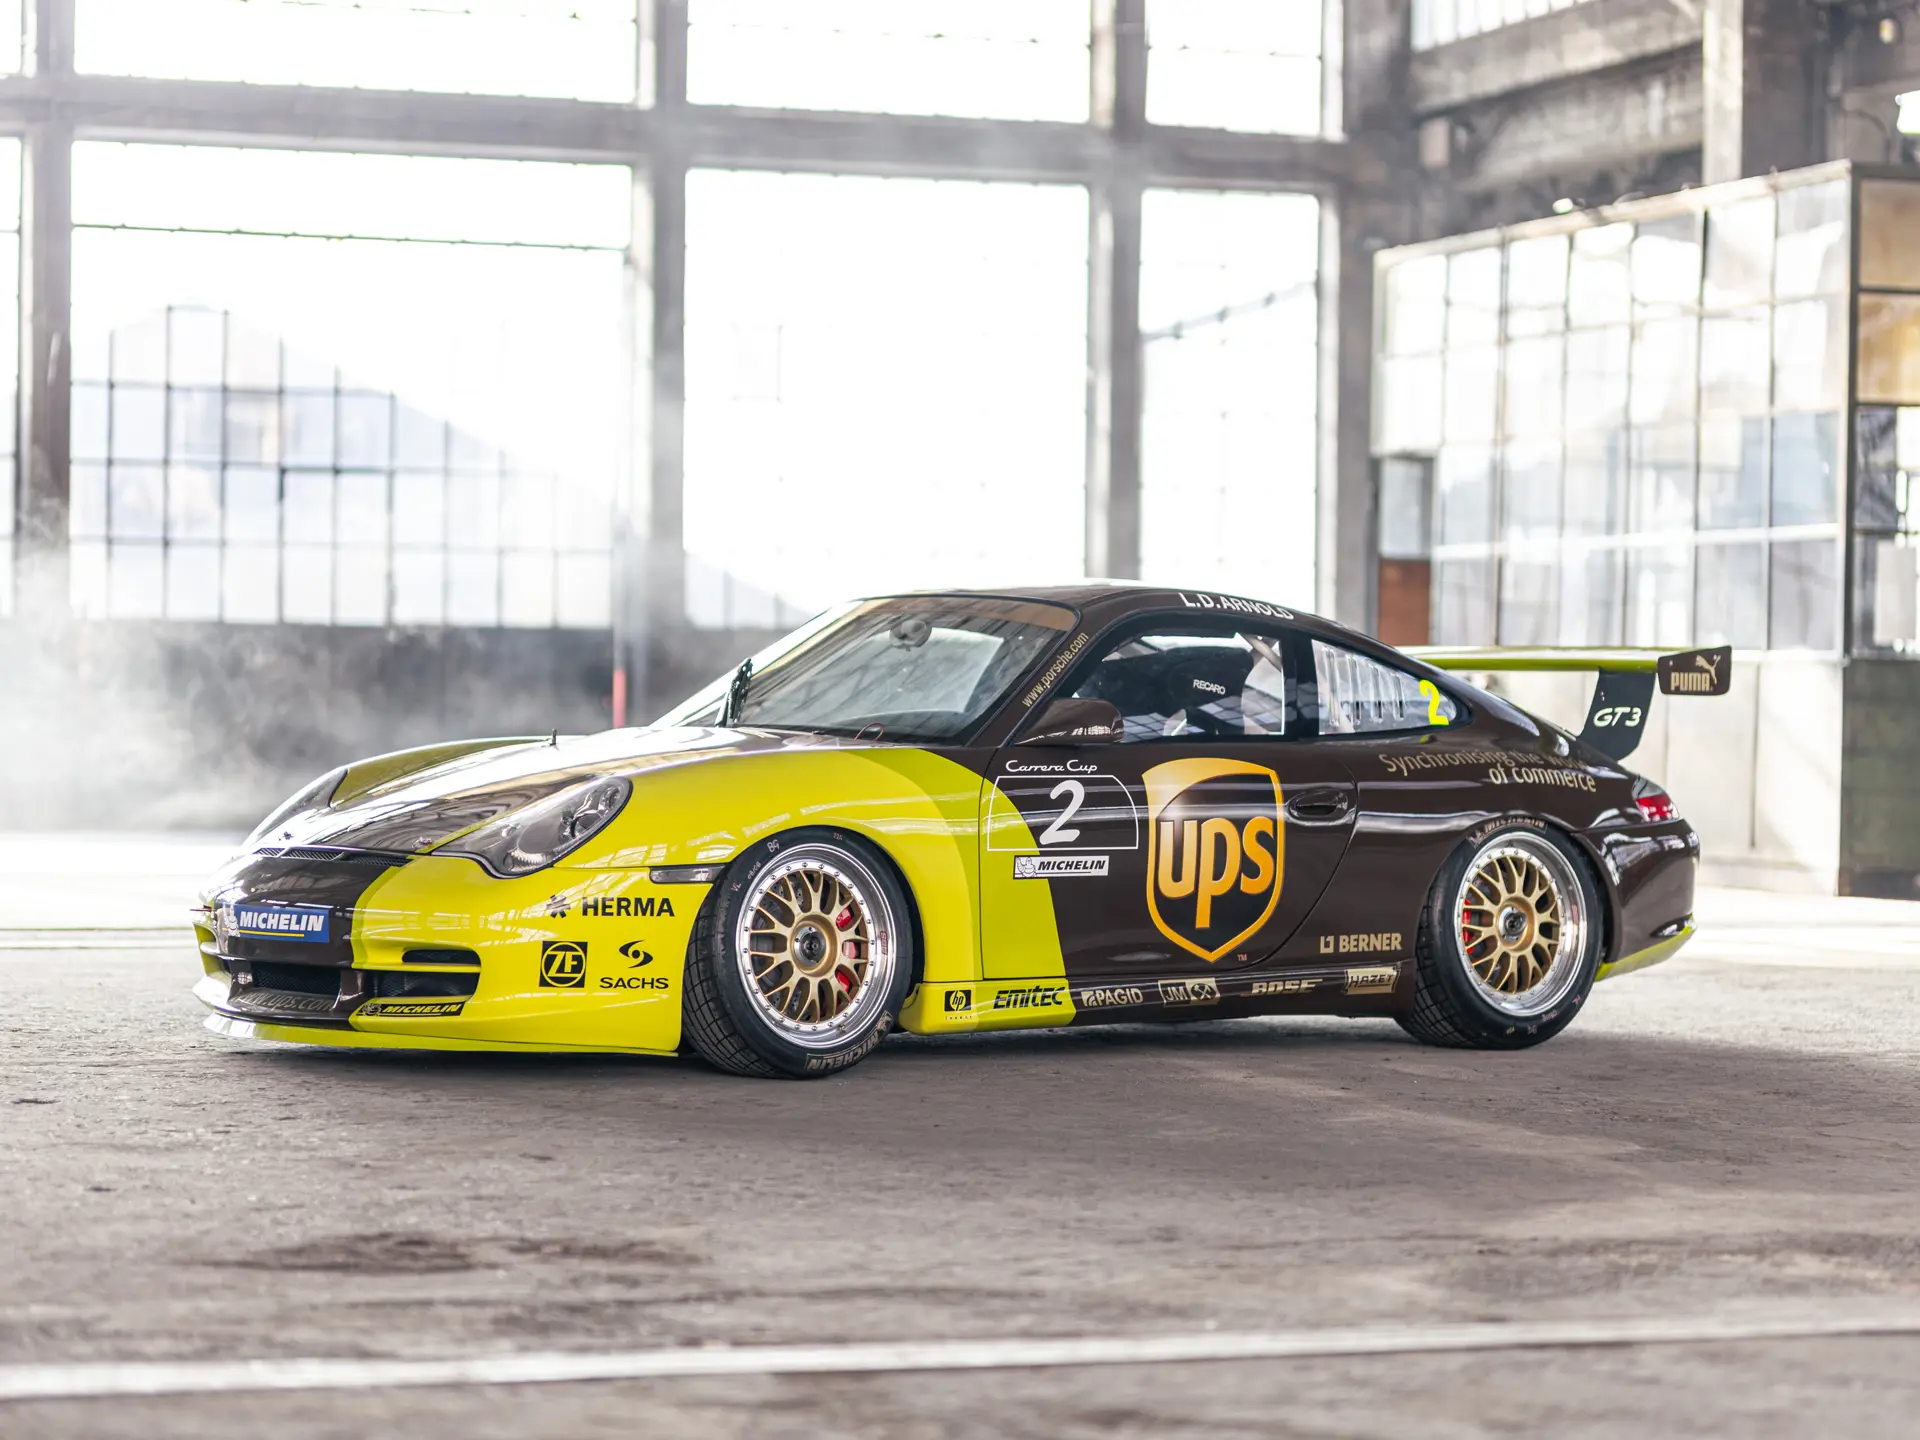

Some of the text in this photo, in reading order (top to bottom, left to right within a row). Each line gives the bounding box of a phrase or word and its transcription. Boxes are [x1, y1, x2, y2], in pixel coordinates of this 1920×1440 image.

[1021, 632, 1089, 707] www.porsche.com
[1192, 679, 1226, 695] RECARO
[1670, 672, 1711, 692] PUMA
[1419, 679, 1449, 726] 2
[1593, 706, 1642, 727] GT3
[1005, 759, 1098, 775] Carrera Cup
[1378, 749, 1516, 776] Synchronising
[1509, 748, 1545, 765] the
[1489, 763, 1597, 792] of commerce
[1039, 779, 1086, 845] 2
[1037, 859, 1106, 872] MICHELIN
[1157, 816, 1275, 929] ups
[581, 897, 675, 917] HERMA
[240, 911, 325, 931] MICHELIN
[1339, 932, 1402, 953] BERNER
[546, 950, 582, 978] ZF
[599, 977, 669, 989] SACHS
[1350, 974, 1395, 989] HAZET
[1095, 987, 1144, 1005] PAGID
[1164, 986, 1188, 1001] JM
[382, 1003, 462, 1014] MICHELIN
[806, 1031, 879, 1070] MICHELIN
